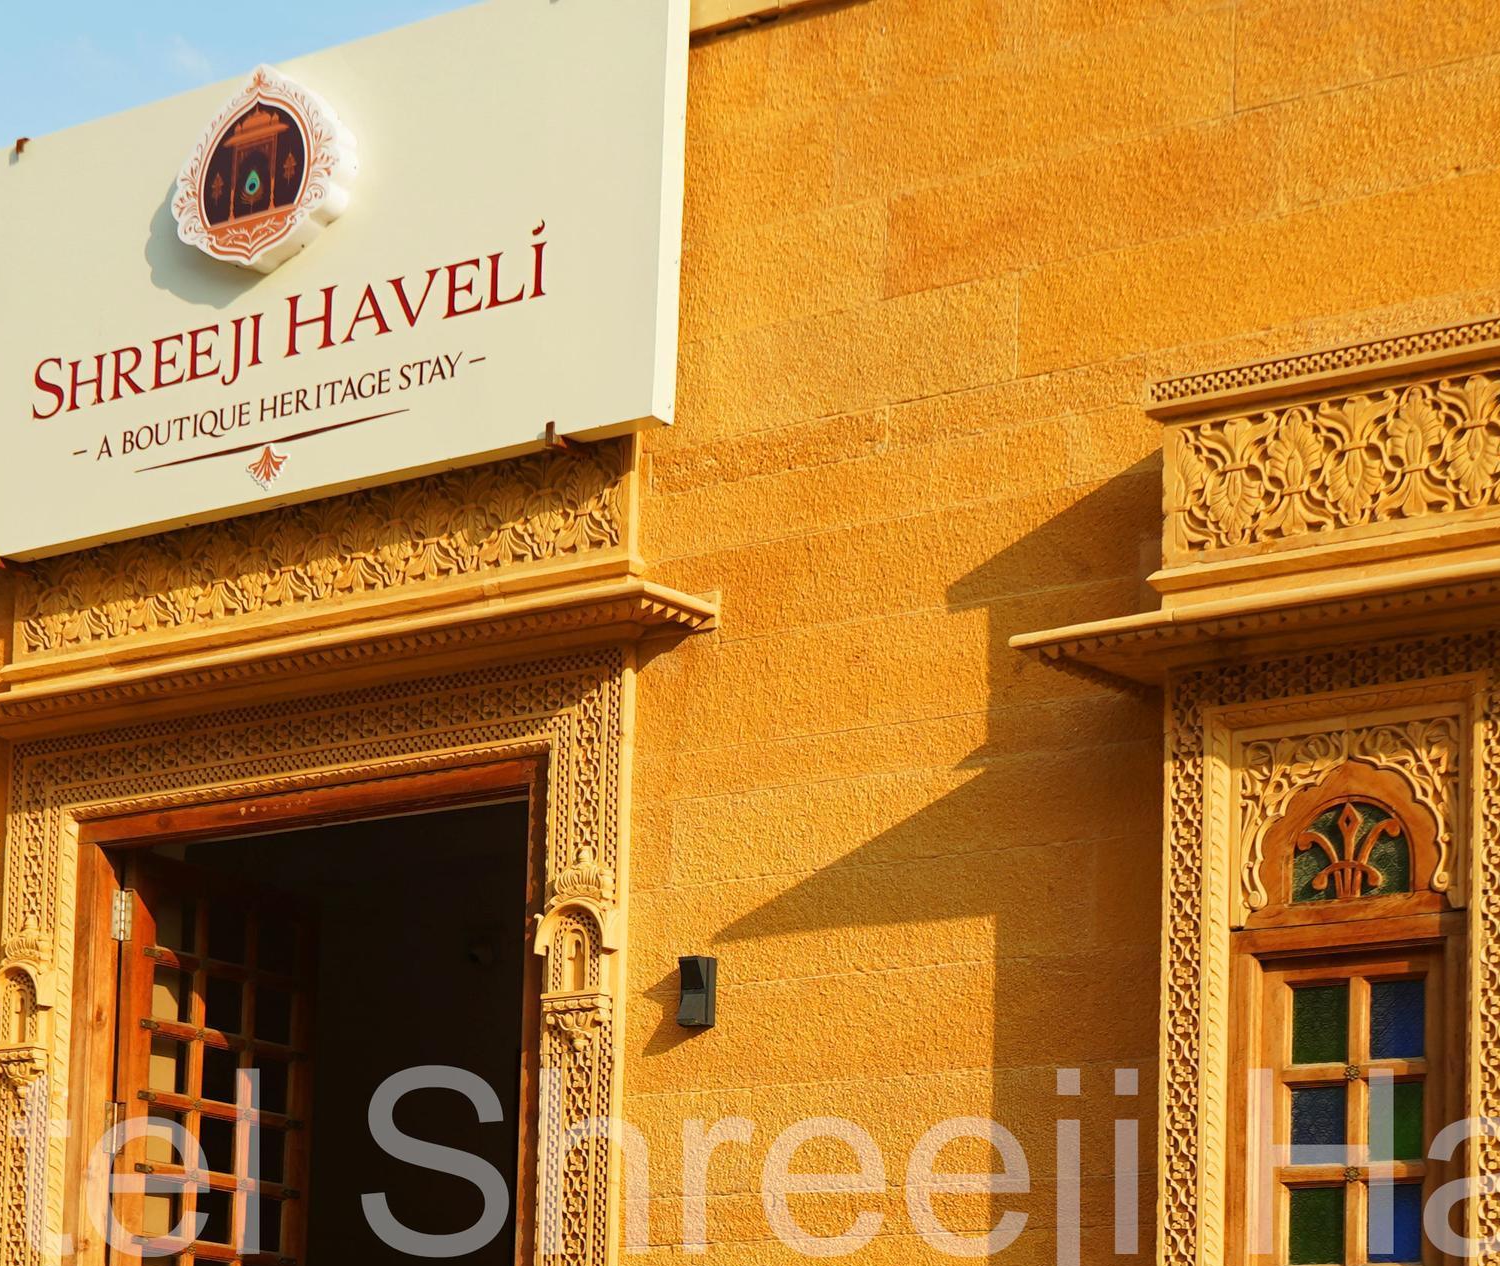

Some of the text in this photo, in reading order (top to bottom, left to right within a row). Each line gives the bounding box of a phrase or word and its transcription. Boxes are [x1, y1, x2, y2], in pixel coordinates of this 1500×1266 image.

[31, 312, 264, 421] SHREEJI
[96, 350, 464, 462] A BOUTIQUE HERITAGE STAY
